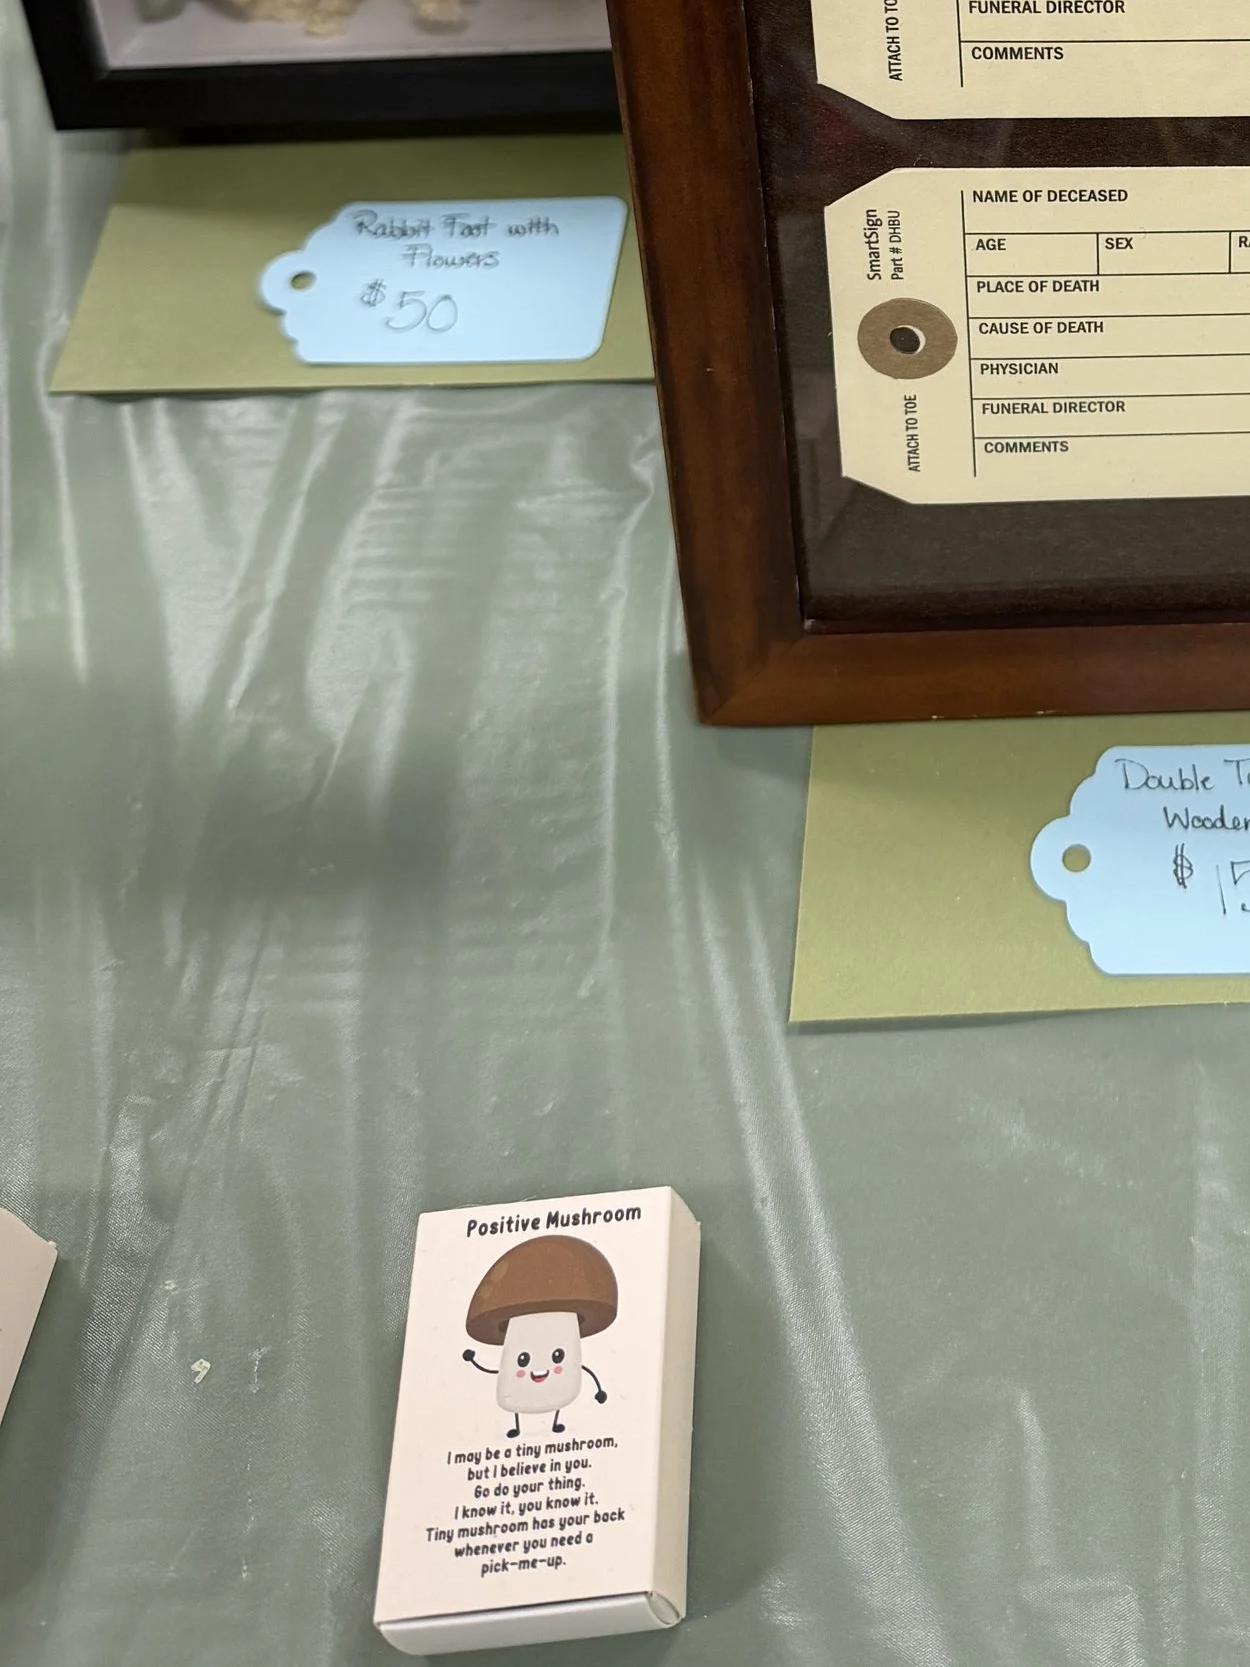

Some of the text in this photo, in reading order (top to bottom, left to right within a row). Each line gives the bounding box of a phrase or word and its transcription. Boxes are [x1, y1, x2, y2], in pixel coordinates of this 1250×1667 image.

[968, 0, 1126, 14] FUNERAL DIRECTOR
[884, 16, 900, 34] TO
[886, 36, 903, 82] ATTACH
[971, 46, 1064, 60] COMMENTS
[972, 189, 1129, 203] NAME OF DECEASED
[863, 209, 883, 281] SmartSign
[887, 210, 904, 280] Part # DHBU
[975, 238, 1007, 251] AGE
[1104, 237, 1134, 250] SEX
[976, 279, 1100, 293] PLACE OF DEATH
[978, 320, 1104, 335] CAUSE OF DEATH
[980, 362, 1059, 376] PHYSICIAN
[982, 400, 1126, 415] FUNERAL DIRECTOR
[902, 393, 921, 473] ATTACH TO TOE
[983, 440, 1069, 454] COMMENTS
[1115, 759, 1213, 790] Double
[466, 1206, 642, 1238] Positive Mushroom
[454, 1451, 482, 1466] may
[485, 1447, 501, 1461] be
[515, 1444, 542, 1459] tiny
[544, 1437, 618, 1455] mushroom,
[467, 1466, 490, 1481] but
[500, 1461, 547, 1478] believe
[549, 1458, 562, 1473] in
[564, 1458, 592, 1474] you.
[474, 1476, 586, 1499] Go do your thing.
[461, 1505, 498, 1520] know
[500, 1500, 515, 1516] it,
[518, 1500, 543, 1517] you
[545, 1496, 581, 1510] know
[584, 1491, 599, 1506] it.
[425, 1507, 625, 1544] Tiny mushroom has your back
[454, 1541, 520, 1558] whenever
[523, 1538, 548, 1555] you
[550, 1530, 583, 1548] need
[480, 1555, 567, 1578] pick-me-up.
